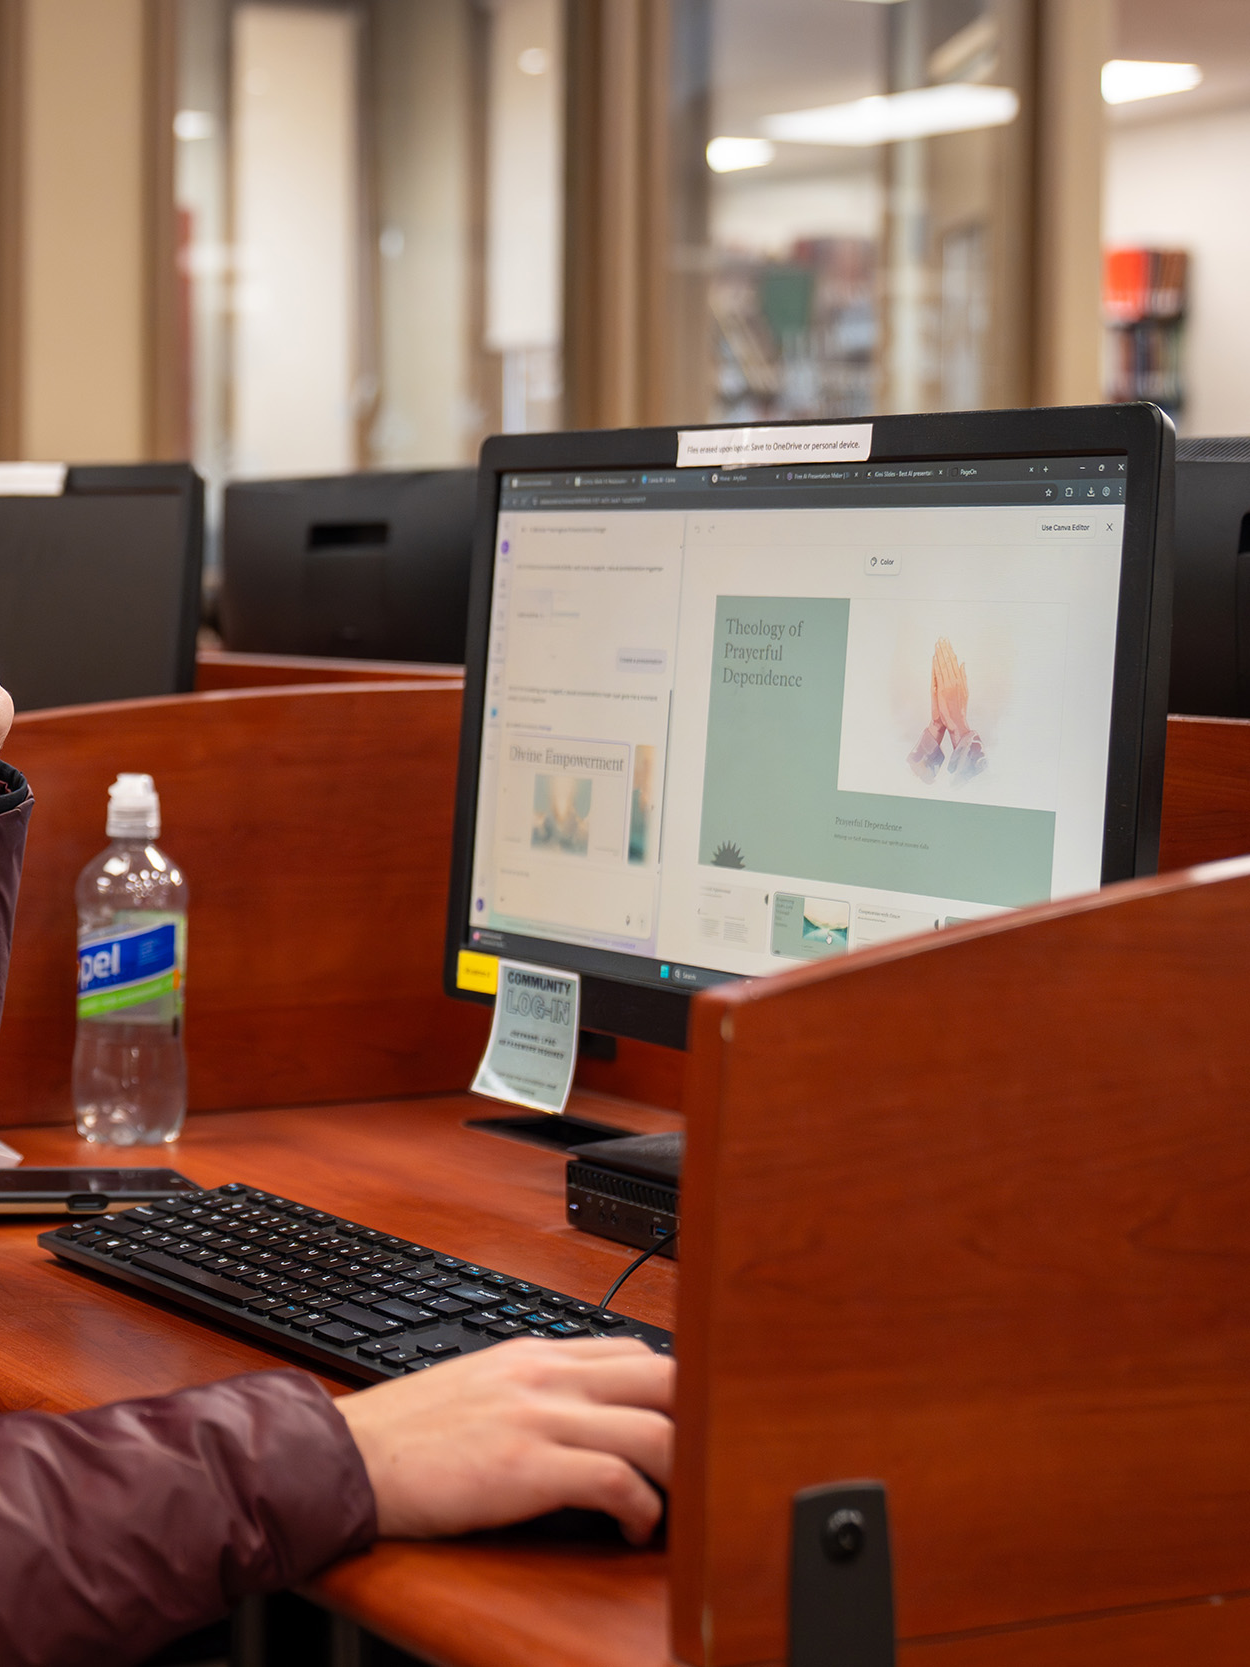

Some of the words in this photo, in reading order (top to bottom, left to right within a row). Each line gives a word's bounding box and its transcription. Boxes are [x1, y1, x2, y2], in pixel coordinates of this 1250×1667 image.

[751, 443, 764, 451] Save
[773, 442, 802, 450] OneDrive
[812, 442, 837, 451] personal
[839, 441, 860, 449] device.
[726, 618, 785, 640] Theology
[789, 621, 804, 637] of
[724, 643, 782, 663] Prayerful
[723, 668, 802, 688] Dependence
[510, 745, 542, 762] Divine
[545, 748, 624, 772] Empowerment
[835, 817, 863, 828] Prayerful
[865, 820, 902, 832] Dependence
[80, 943, 121, 990] pel
[508, 972, 571, 995] COMMUNITY
[506, 989, 570, 1025] LOG-IN
